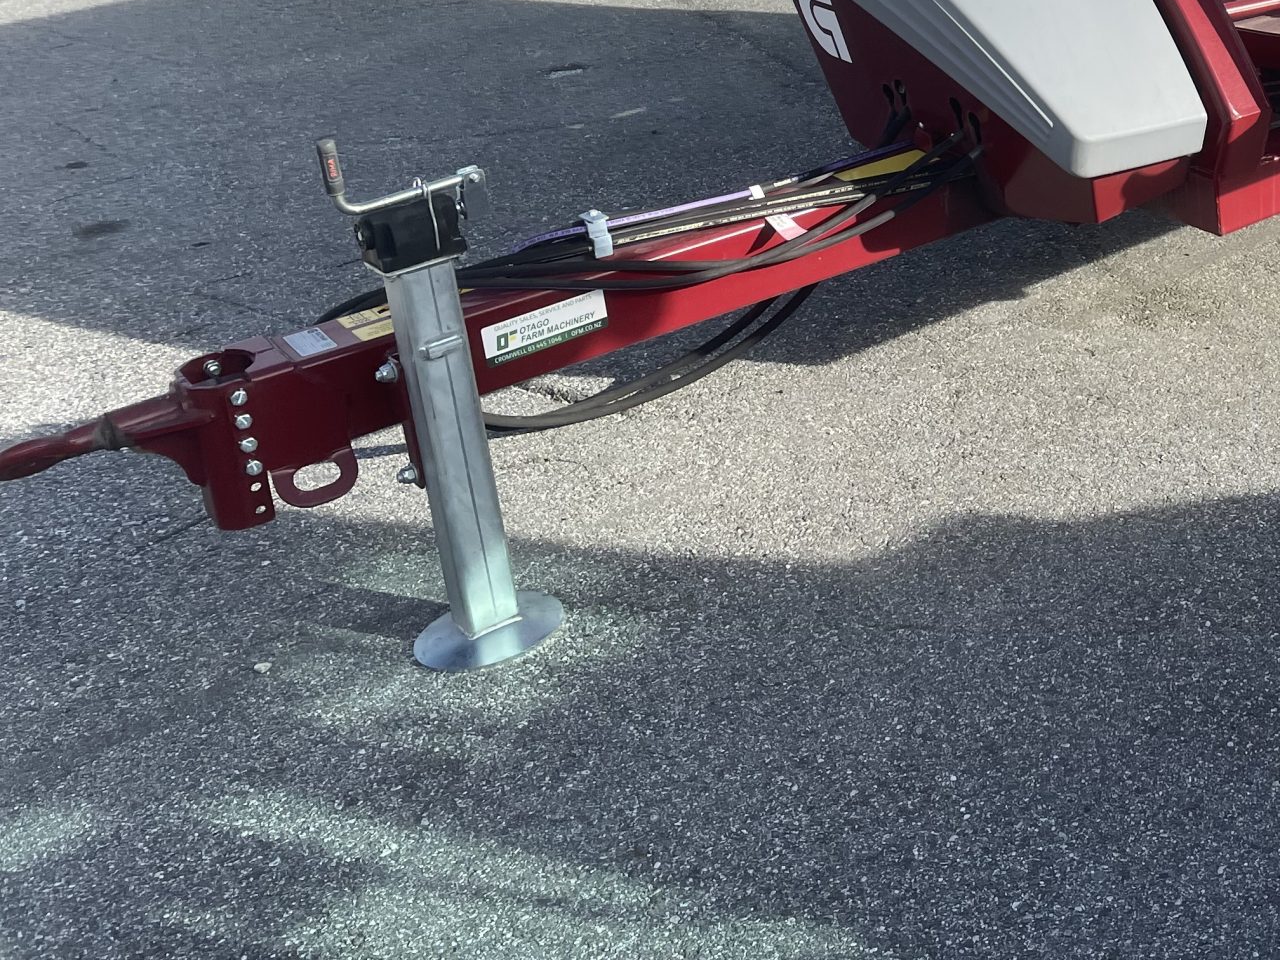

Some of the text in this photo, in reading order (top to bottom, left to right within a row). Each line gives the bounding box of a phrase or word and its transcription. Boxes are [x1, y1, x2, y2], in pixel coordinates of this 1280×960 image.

[494, 348, 527, 364] CROMWELL
[570, 320, 603, 337] OFM.CO.NZ
[519, 318, 550, 336] OTAGO
[521, 311, 596, 344] FARM MACHINERY
